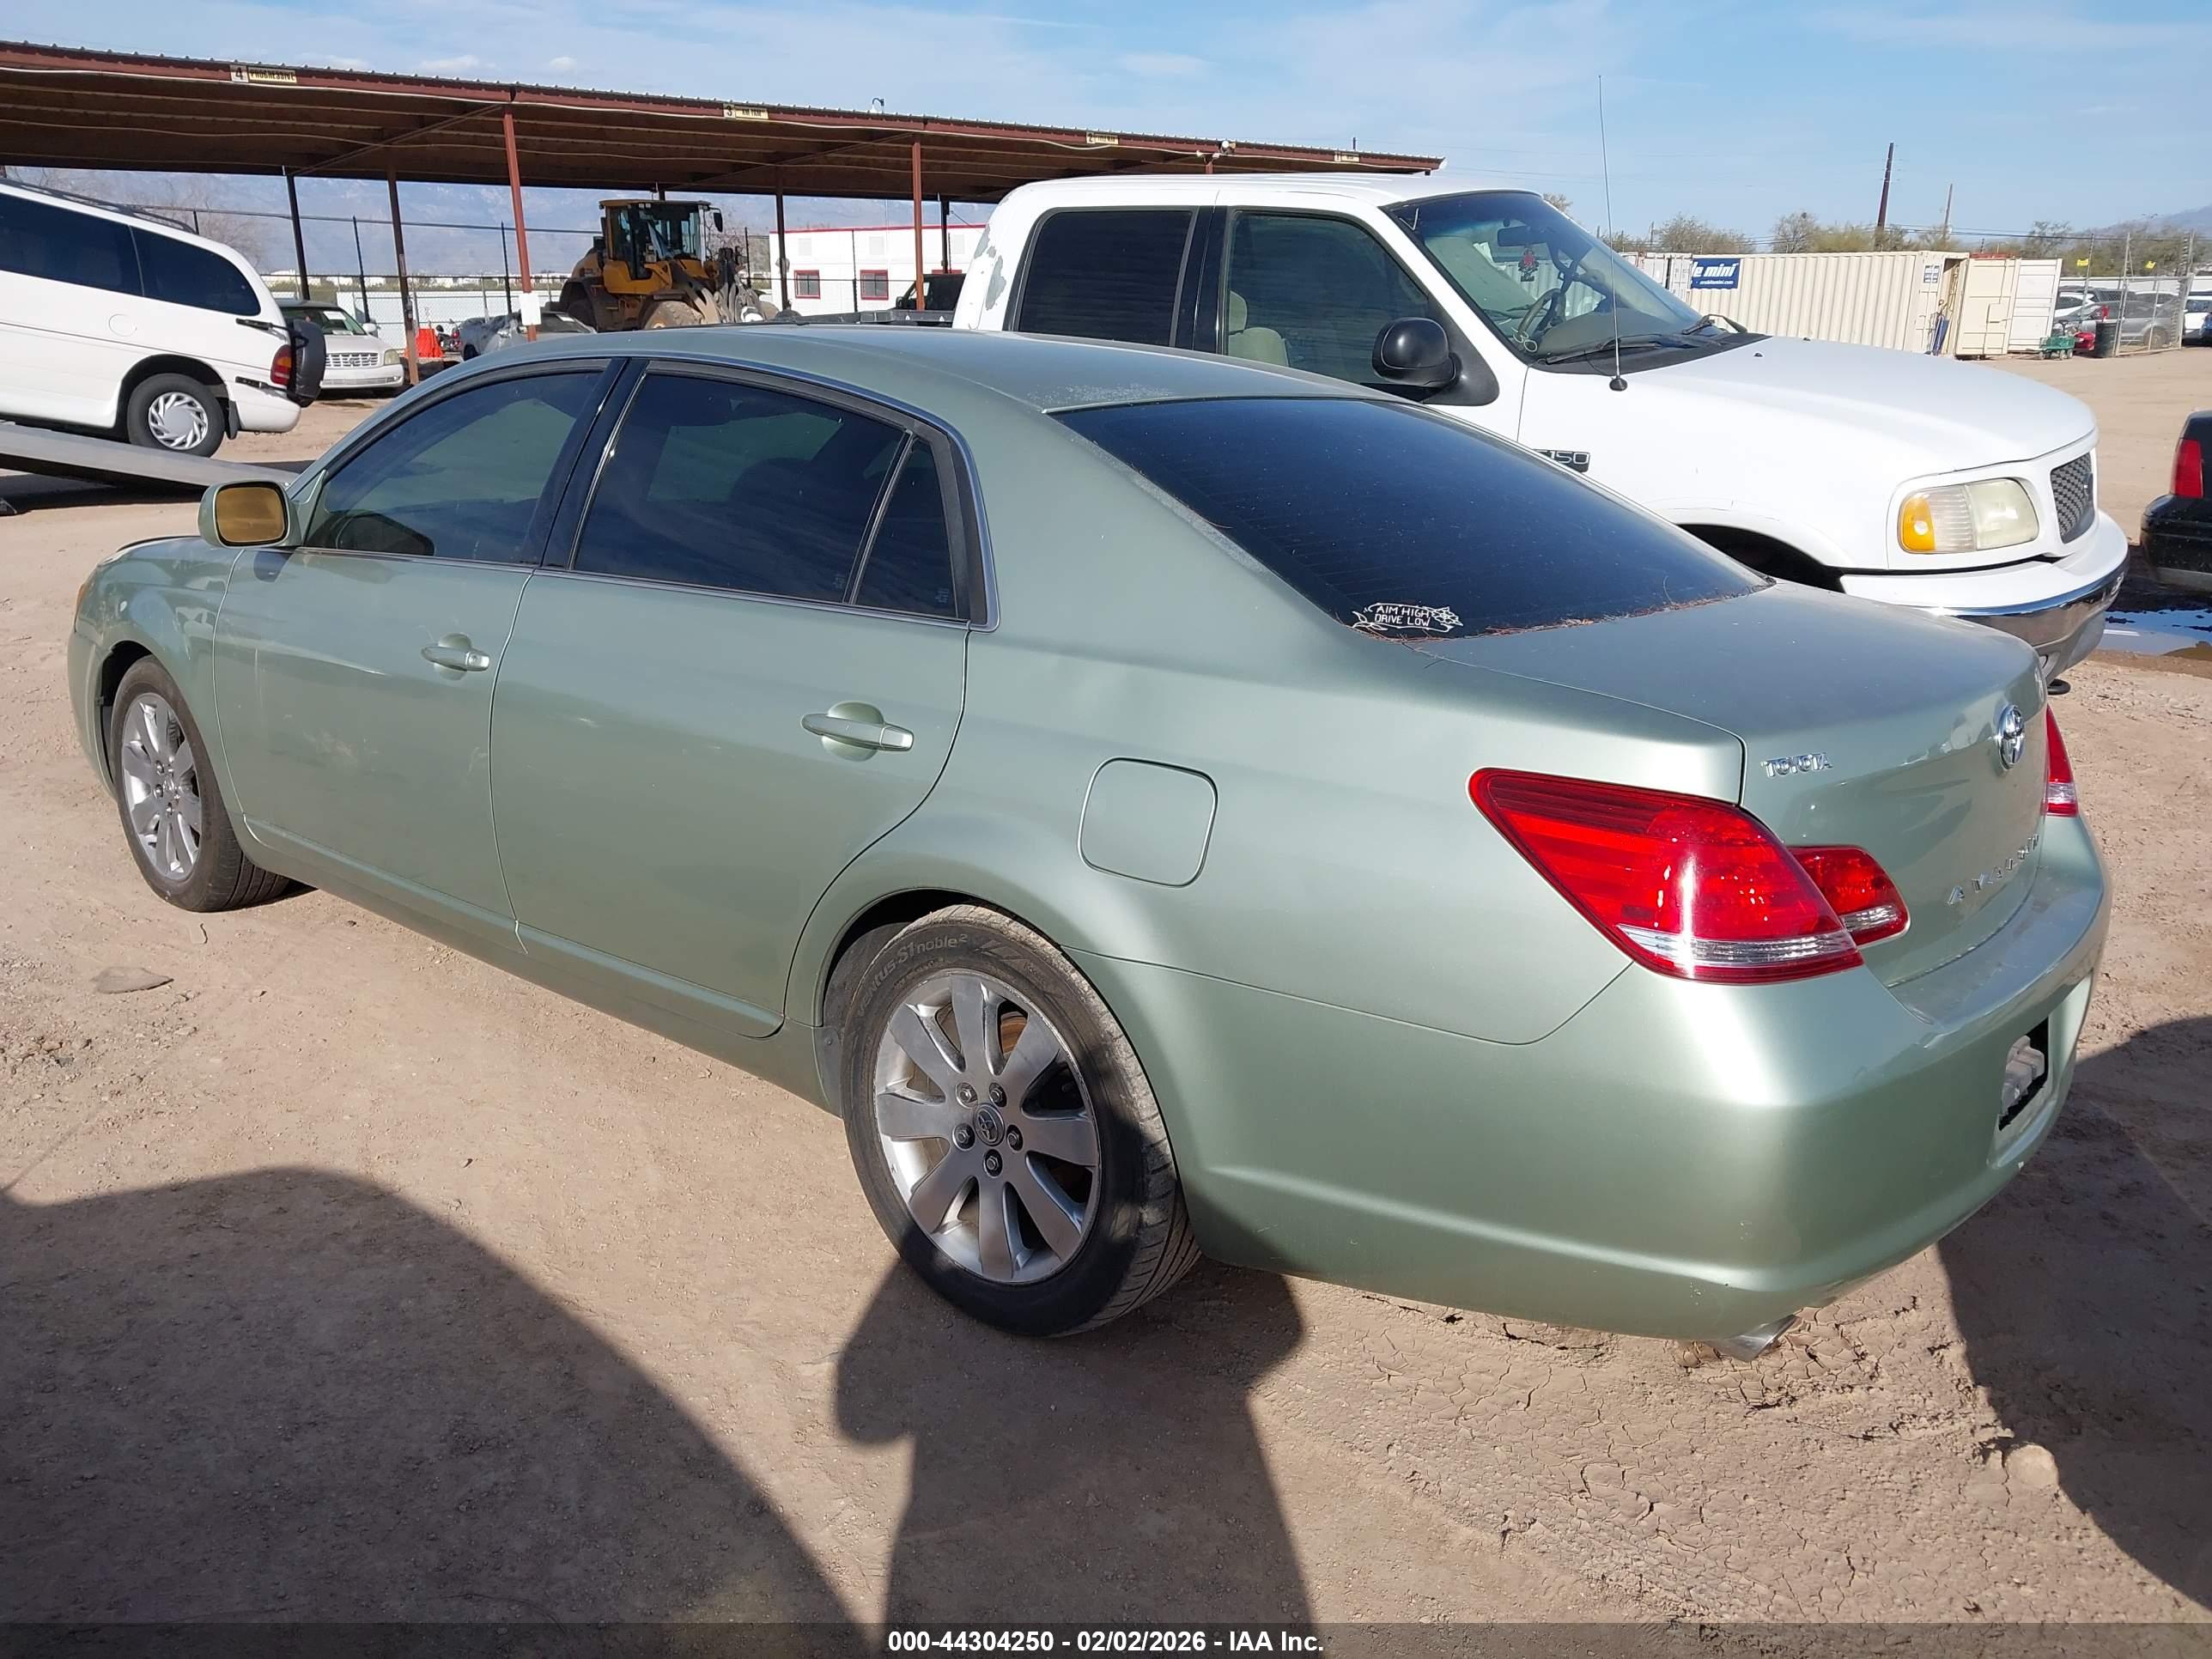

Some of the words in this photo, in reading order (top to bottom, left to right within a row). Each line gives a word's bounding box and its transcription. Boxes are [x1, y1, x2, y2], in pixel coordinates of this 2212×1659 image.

[235, 67, 243, 80] 4
[249, 69, 295, 81] PROGRESSIVE
[1692, 261, 1705, 277] le
[1703, 263, 1736, 277] mini
[1536, 449, 1590, 465] 150
[1376, 605, 1398, 615] AIM
[1401, 606, 1430, 618] HIGH
[1374, 613, 1403, 624] DRIVE
[1407, 617, 1431, 627] LOW
[1760, 752, 1833, 778] TOYOTA
[1947, 833, 2040, 906] AVALON
